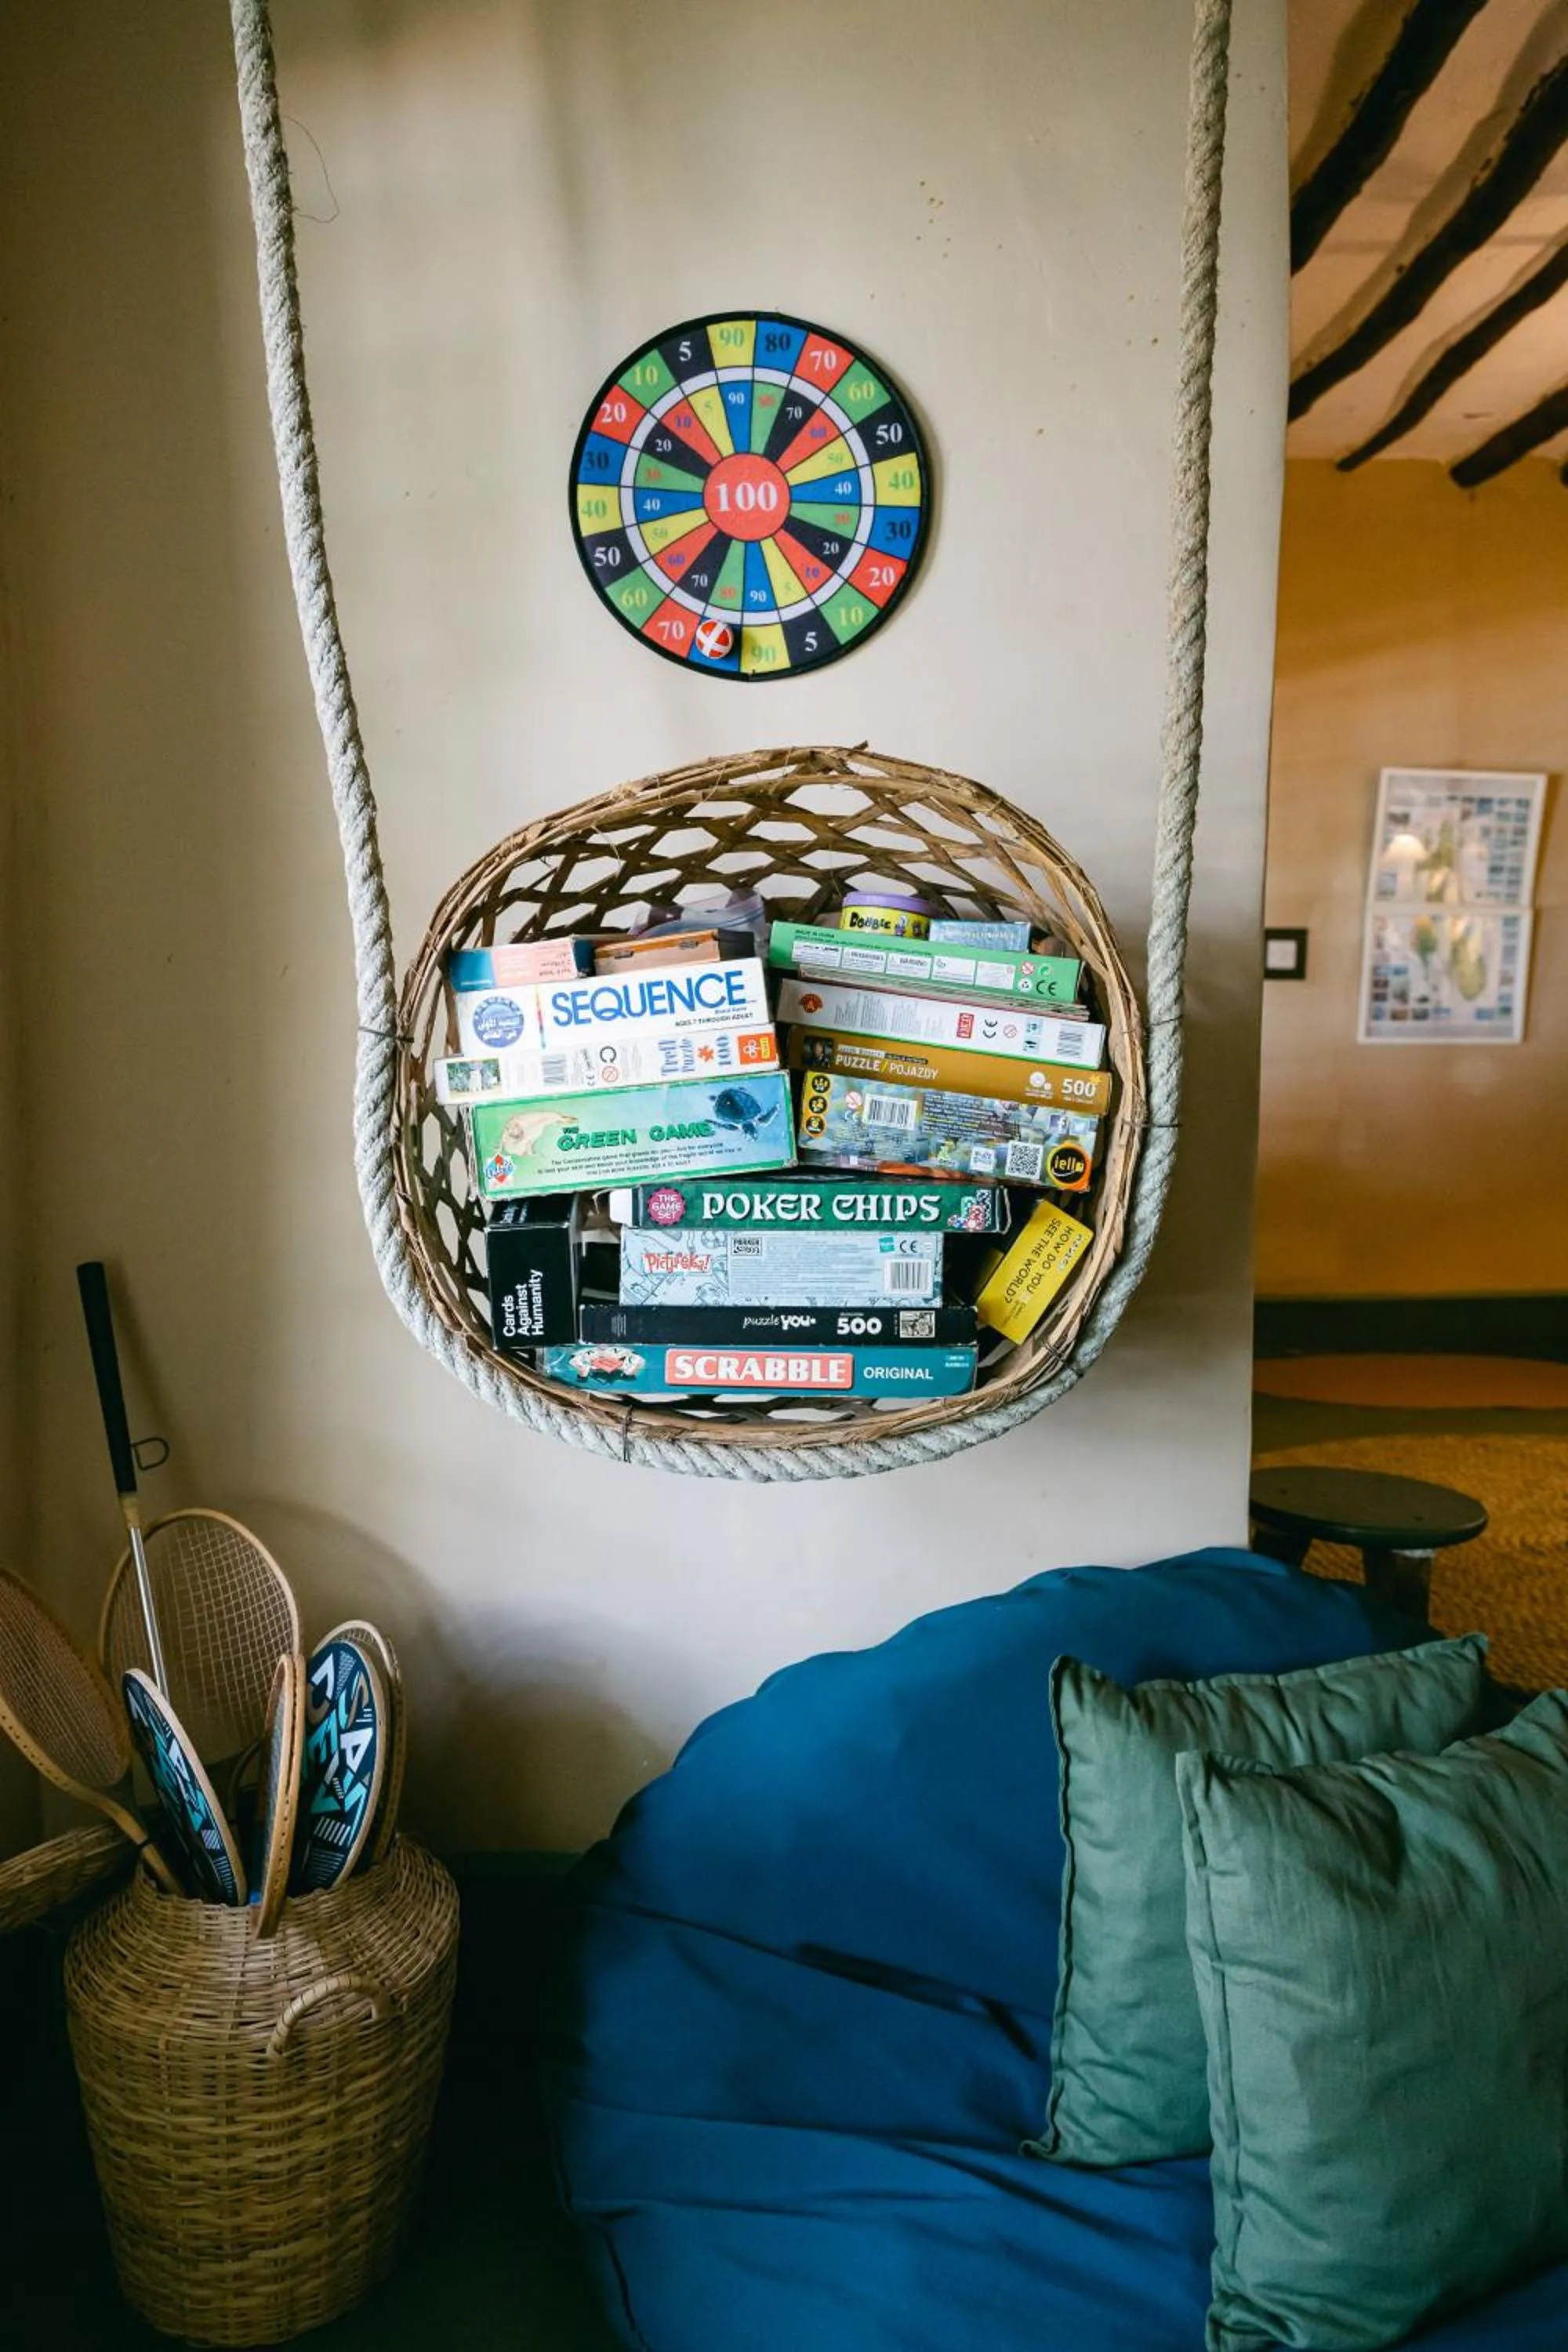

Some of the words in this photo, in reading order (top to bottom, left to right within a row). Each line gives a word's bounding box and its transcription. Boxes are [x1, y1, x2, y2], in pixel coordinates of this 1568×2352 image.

[720, 326, 744, 347] 90
[765, 331, 791, 351] 80
[680, 341, 691, 361] 5
[810, 349, 837, 371] 70
[633, 366, 658, 384] 10
[728, 392, 744, 405] 90
[849, 379, 875, 401] 60
[601, 402, 626, 423] 20
[676, 416, 691, 427] 10
[786, 406, 802, 419] 70
[877, 423, 902, 444] 50
[655, 439, 671, 452] 20
[586, 451, 609, 470] 30
[834, 483, 851, 495] 40
[888, 471, 914, 490] 40
[643, 499, 660, 512] 40
[715, 481, 778, 512] 100
[583, 499, 607, 518] 40
[652, 527, 668, 539] 50
[887, 521, 911, 540] 30
[594, 546, 620, 567] 50
[823, 542, 839, 555] 20
[668, 554, 684, 565] 60
[691, 575, 707, 587] 70
[805, 566, 819, 578] 10
[869, 566, 895, 587] 20
[622, 588, 648, 608] 60
[751, 590, 766, 603] 90
[839, 606, 862, 626] 10
[659, 620, 684, 641] 70
[805, 631, 818, 651] 5
[752, 644, 776, 663] 90
[1036, 979, 1058, 996] CE
[551, 971, 746, 1026] SEQUENCE
[716, 1036, 731, 1065] 100
[1062, 1078, 1096, 1097] 500
[557, 1129, 637, 1151] GREEN
[649, 1121, 715, 1142] GAME
[1054, 1156, 1084, 1173] iello
[652, 1203, 681, 1211] GAME
[702, 1192, 822, 1221] POKER
[832, 1194, 941, 1221] CHIPS
[1044, 1217, 1062, 1239] SEE
[899, 1240, 918, 1254] CE
[1031, 1236, 1050, 1258] THE
[1051, 1225, 1075, 1254] HOW
[644, 1252, 711, 1273] Pictureka!
[1040, 1252, 1057, 1271] DO
[1000, 1256, 1037, 1304] WORLD?
[1024, 1270, 1045, 1294] YOU
[515, 1283, 532, 1336] Against
[528, 1269, 545, 1335] Humanity
[502, 1294, 517, 1337] Cards
[837, 1317, 882, 1335] 500
[675, 1356, 845, 1383] SCRABBLE
[863, 1367, 934, 1381] ORIGINAL
